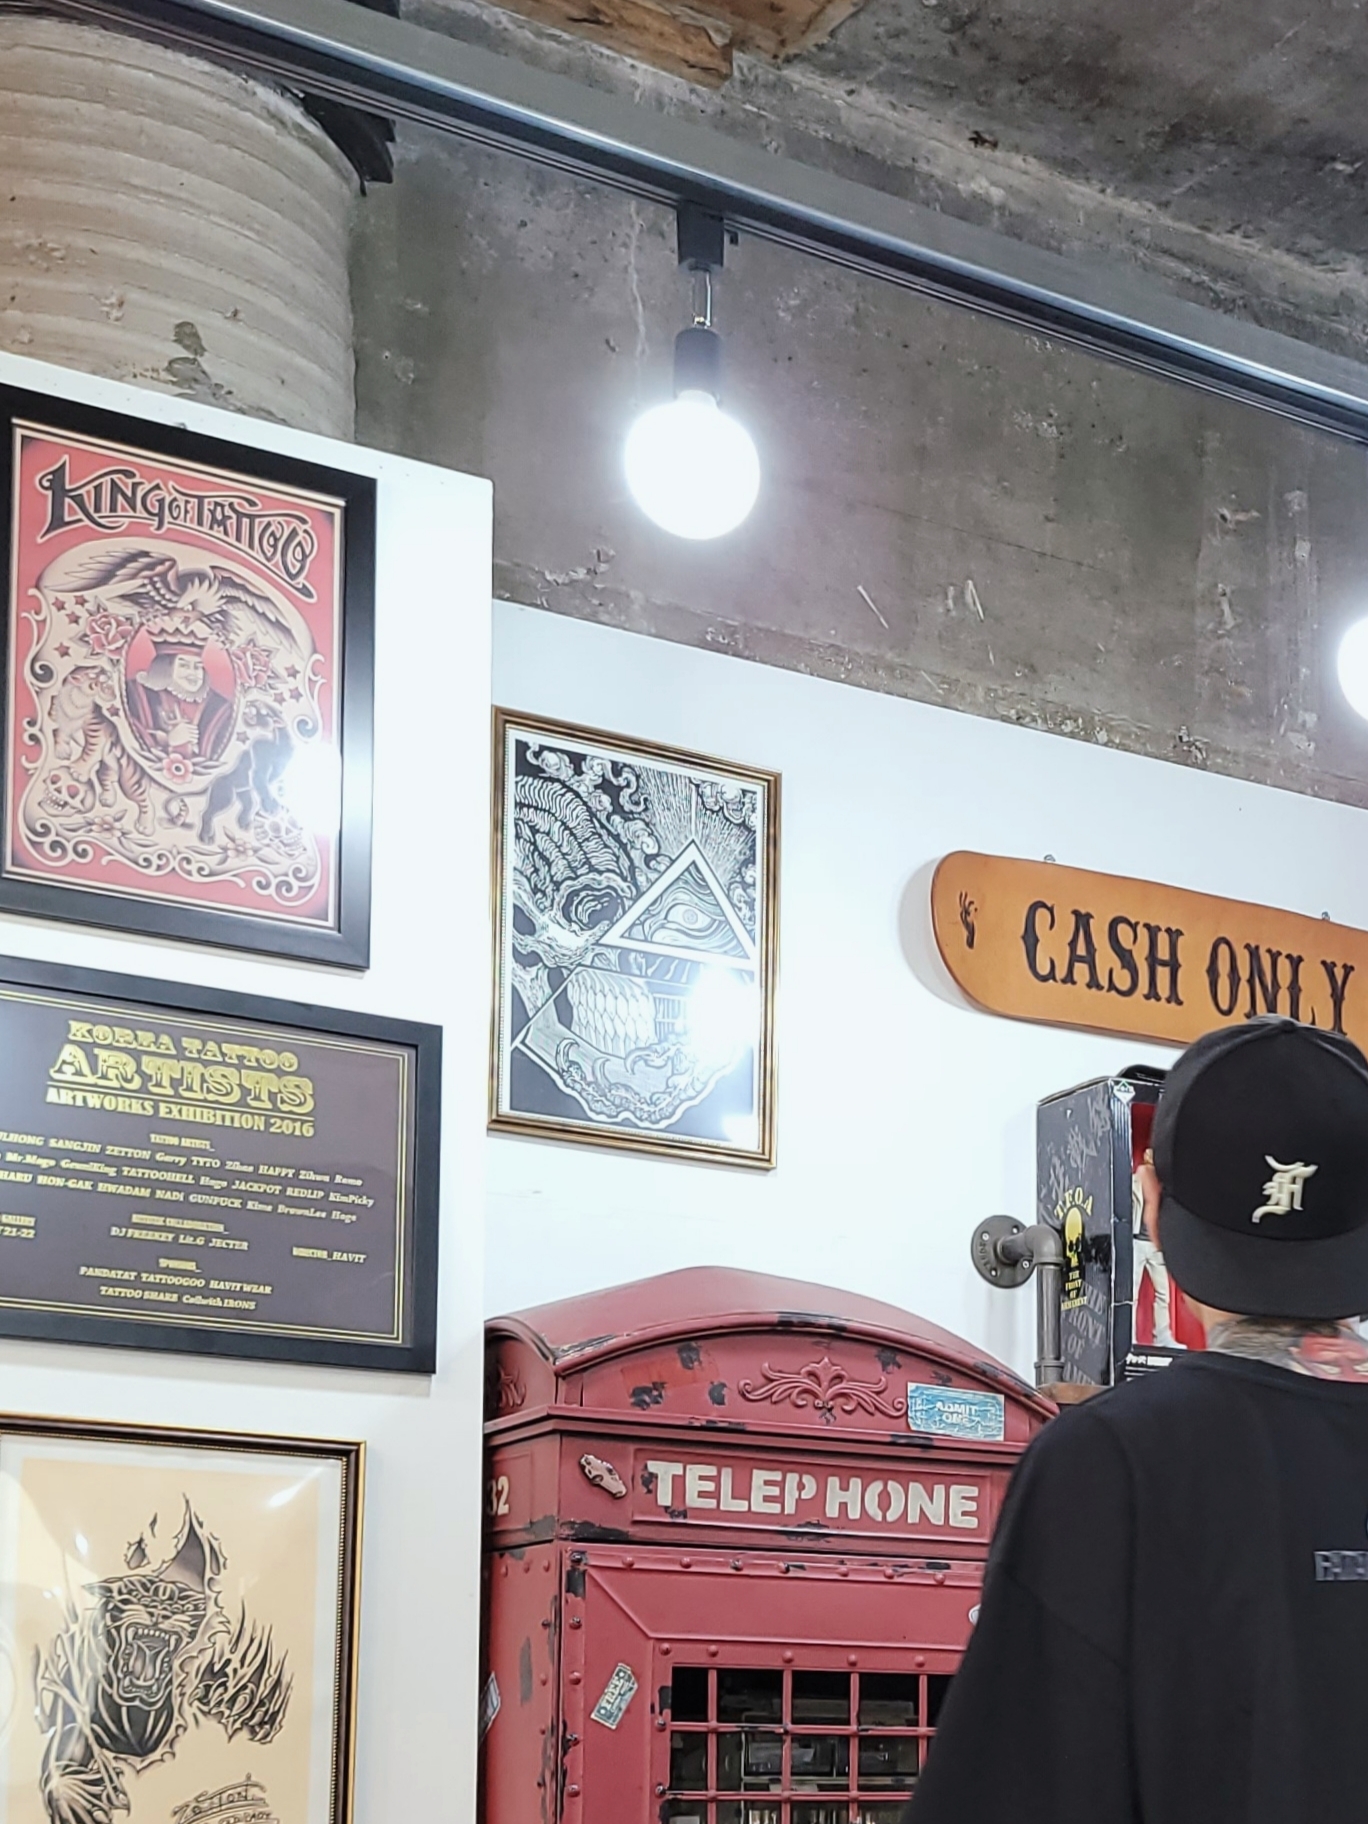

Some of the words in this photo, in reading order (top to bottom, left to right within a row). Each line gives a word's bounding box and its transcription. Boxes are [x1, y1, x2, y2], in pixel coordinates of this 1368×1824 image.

[37, 455, 168, 543] KING
[1021, 900, 1185, 1007] CASH
[1205, 937, 1356, 1036] ONLY
[68, 1020, 172, 1055] KOREA
[181, 1036, 298, 1071] TATTOO
[50, 1044, 315, 1113] ARTISTS
[46, 1087, 154, 1116] ARTWORKS
[159, 1103, 265, 1132] EXHIBITION
[270, 1118, 315, 1137] 2016
[105, 1146, 151, 1159] ZETTON
[191, 1156, 220, 1168] TYTO
[258, 1165, 296, 1178] HAPPY
[232, 1180, 282, 1195] JACKPOT
[286, 1187, 324, 1199] REDLIP
[935, 1401, 978, 1416] ADMIT
[646, 1460, 978, 1528] TELEPHONE
